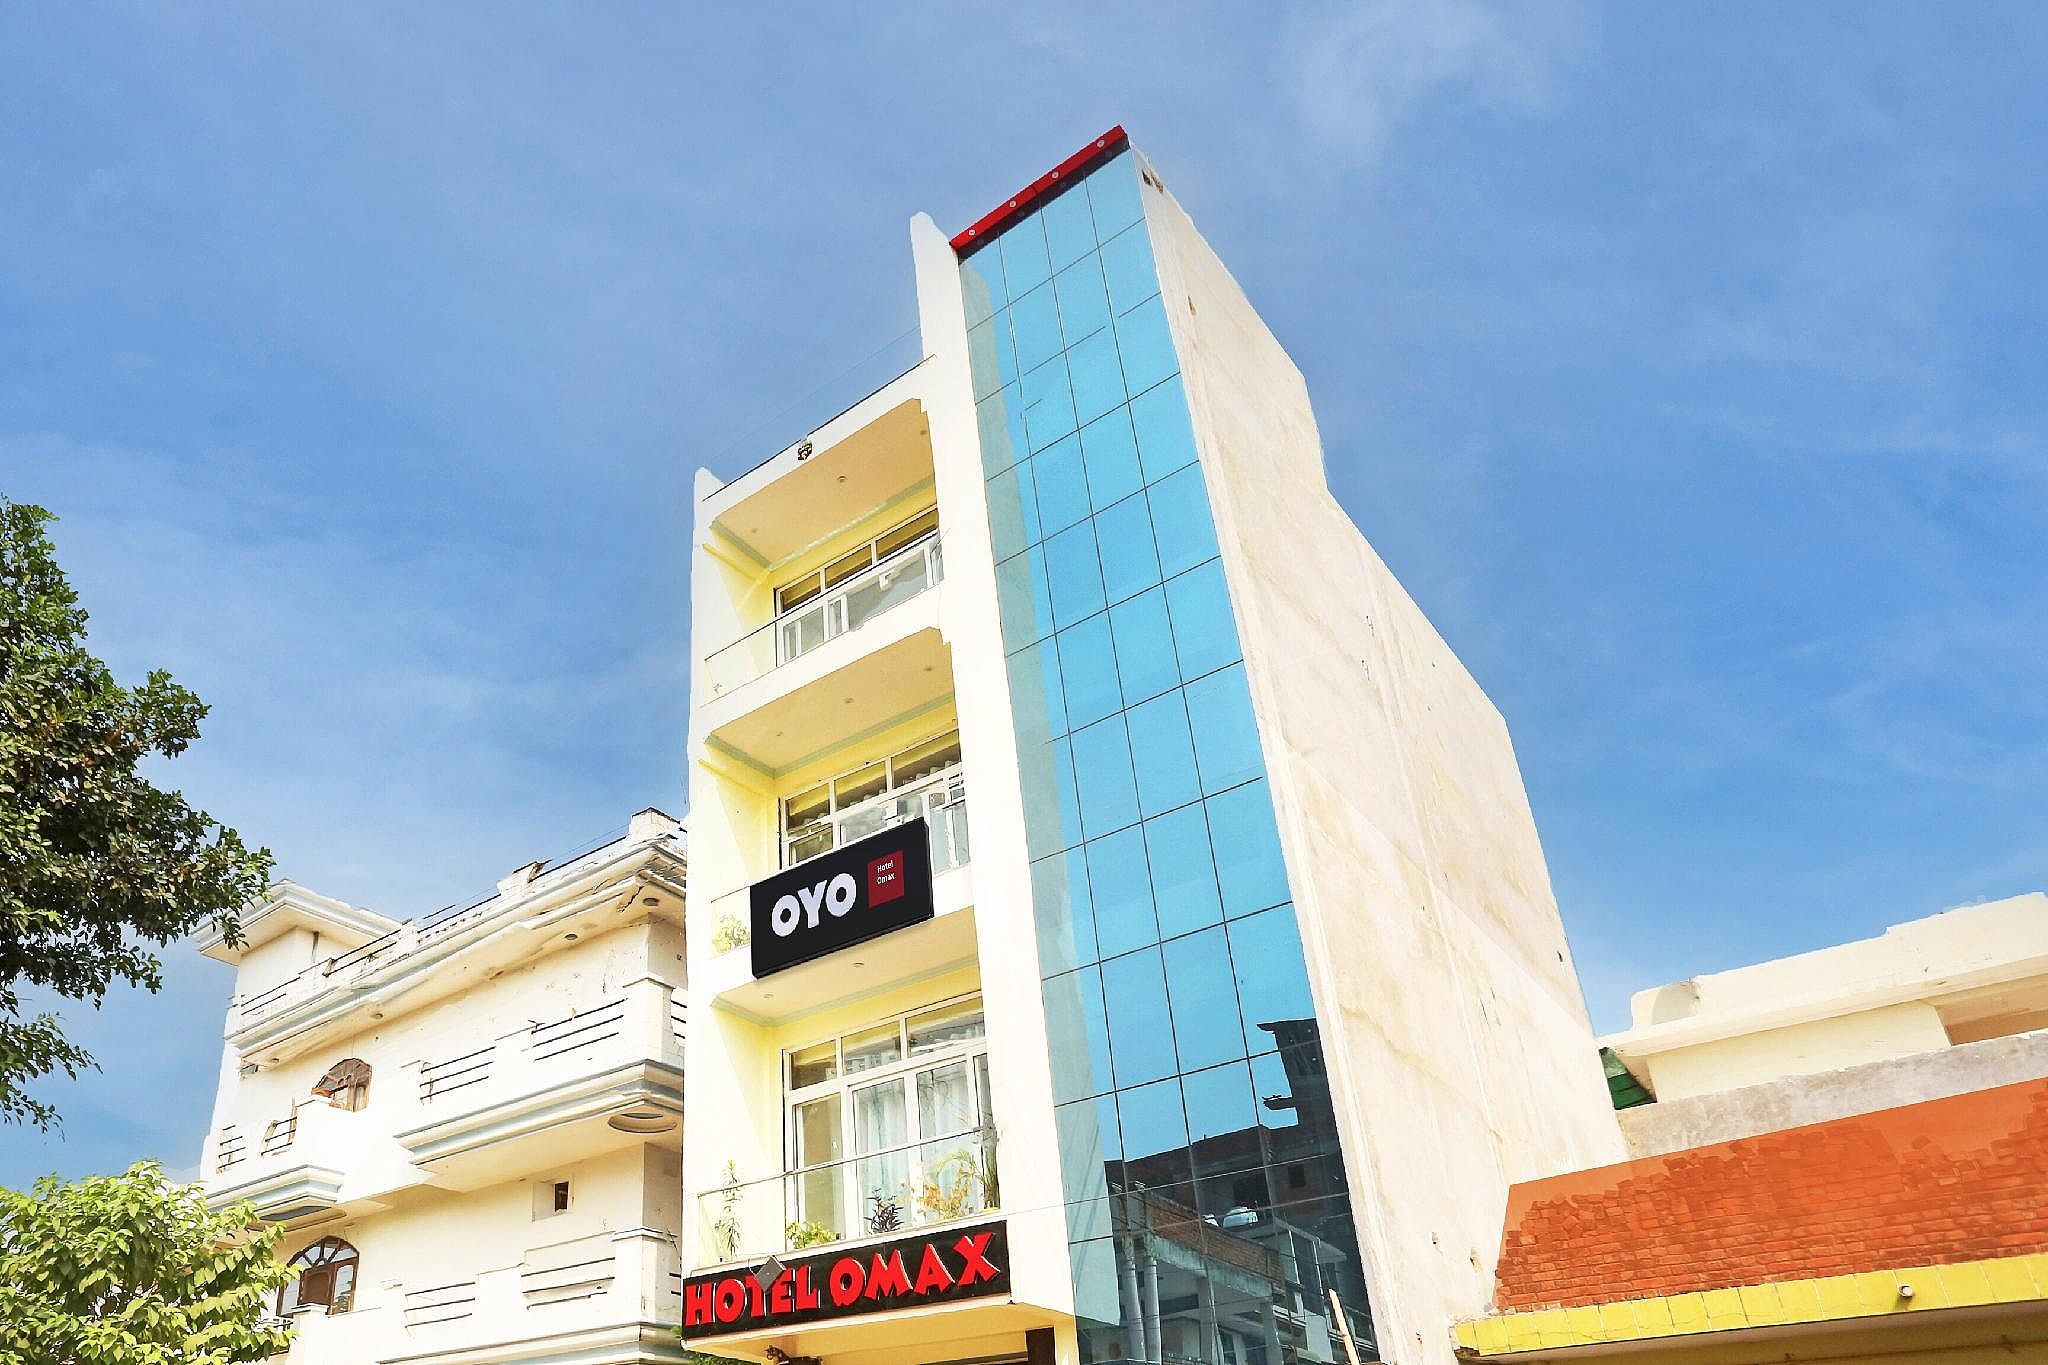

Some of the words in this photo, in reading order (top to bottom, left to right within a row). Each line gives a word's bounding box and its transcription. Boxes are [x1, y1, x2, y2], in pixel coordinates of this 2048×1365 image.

[876, 872, 896, 885] Omax
[877, 860, 894, 873] Hotel
[771, 873, 857, 937] OYO
[685, 1264, 820, 1327] HOTEL
[829, 1232, 1000, 1307] OMAX
